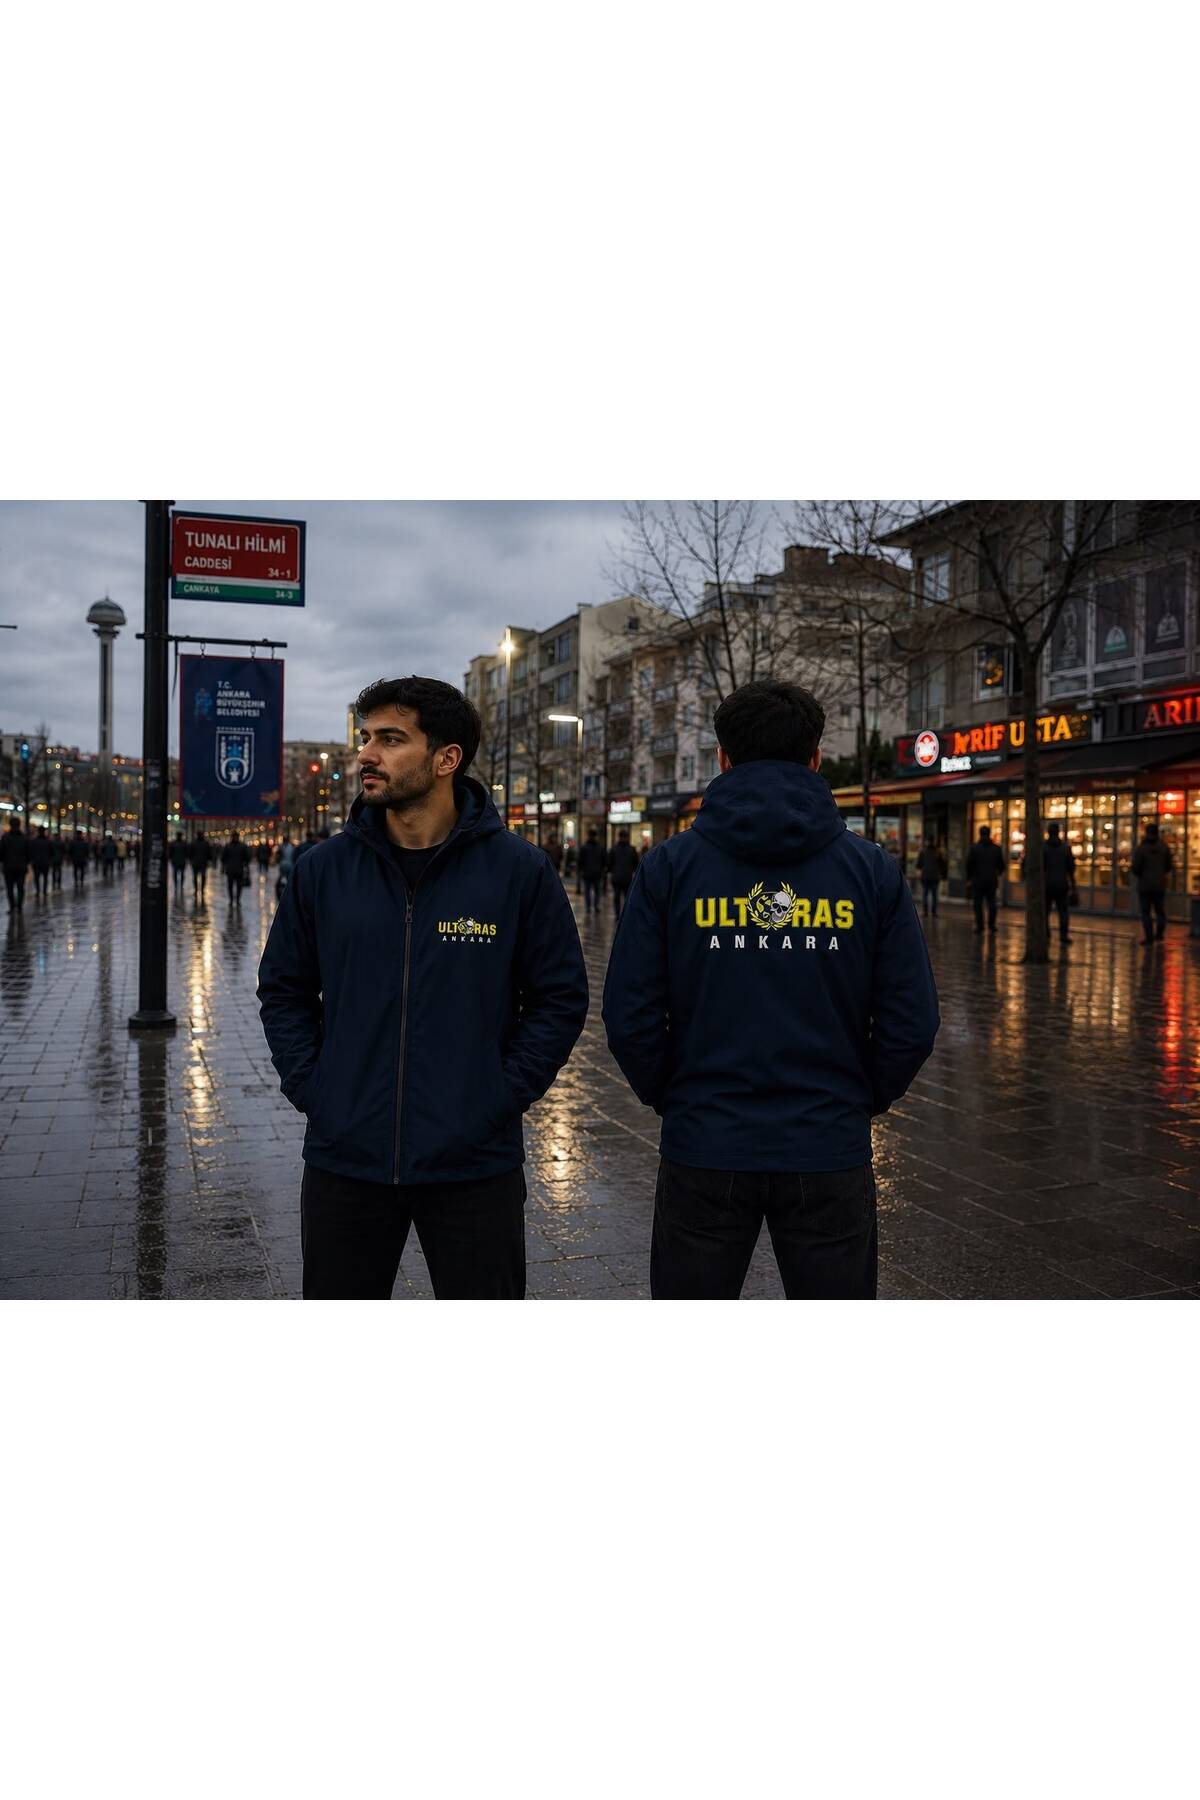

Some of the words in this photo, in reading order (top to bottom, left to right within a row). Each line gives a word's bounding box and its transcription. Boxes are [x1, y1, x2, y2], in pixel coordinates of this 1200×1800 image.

[185, 531, 240, 551] TUNALI
[245, 533, 286, 554] HİLMİ
[184, 556, 232, 570] CADDESİ
[216, 690, 251, 699] ANKARA
[442, 935, 492, 944] ANKARA
[709, 935, 839, 950] ANKARA
